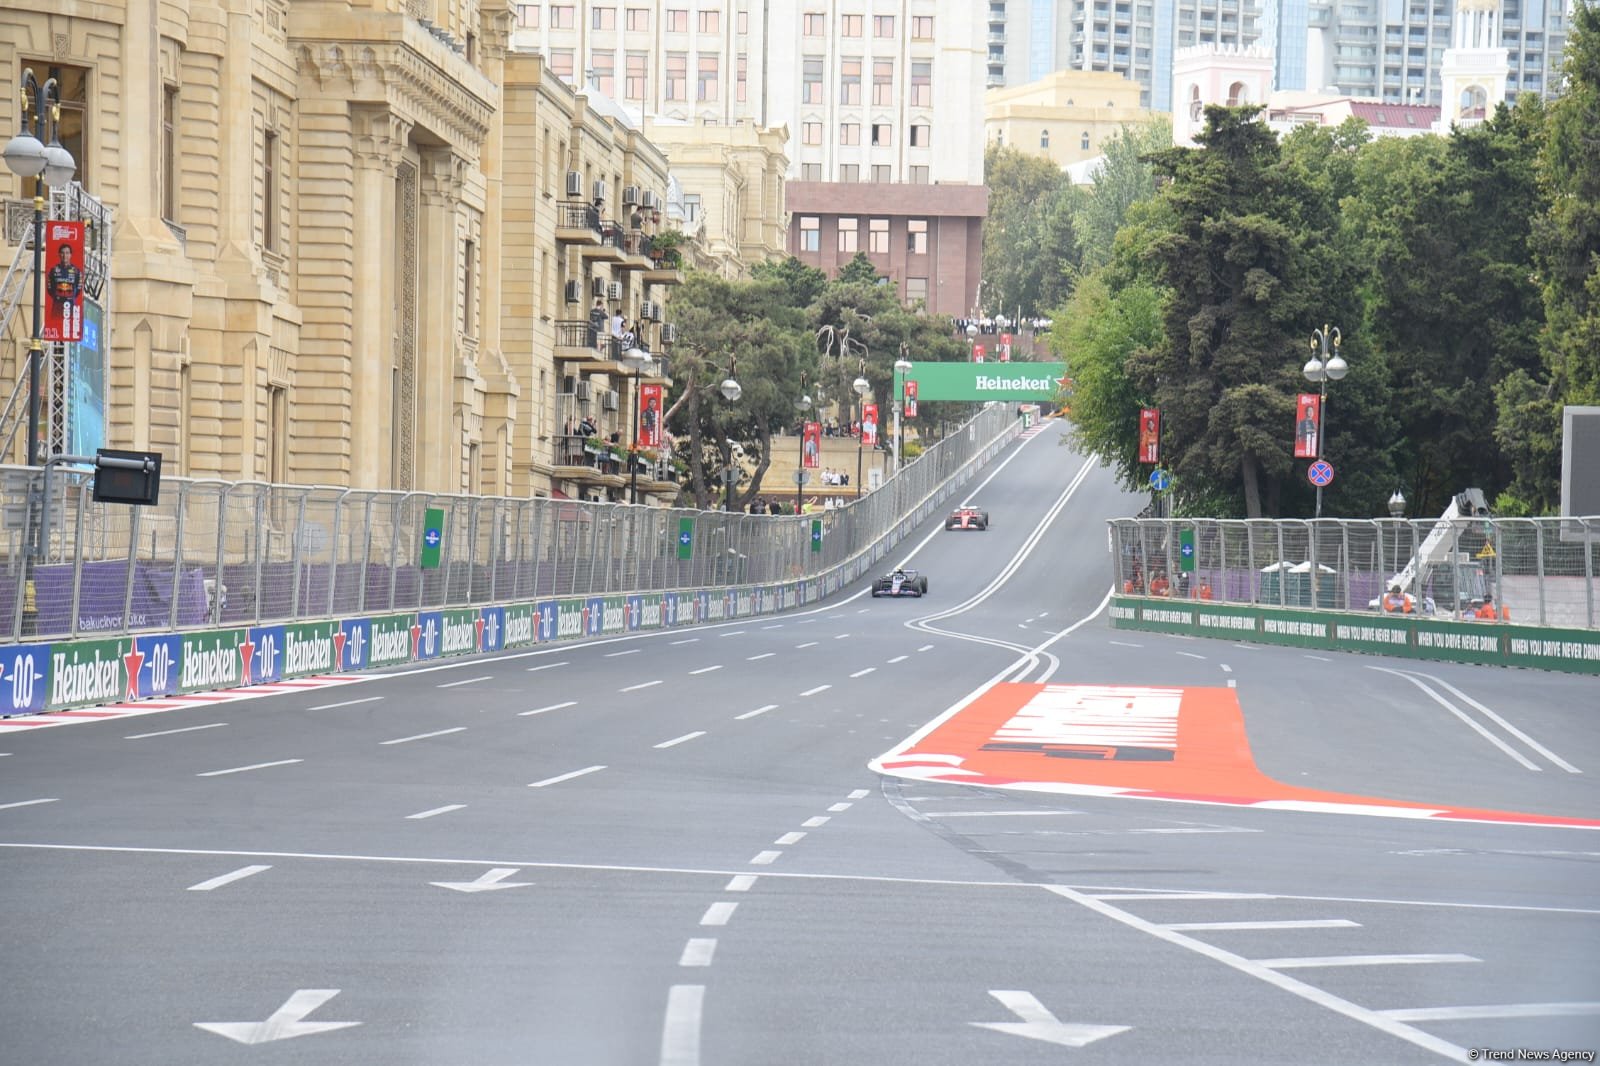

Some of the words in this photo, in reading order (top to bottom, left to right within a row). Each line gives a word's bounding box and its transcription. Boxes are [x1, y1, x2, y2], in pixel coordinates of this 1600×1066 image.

[975, 375, 1050, 390] Heineken
[370, 622, 409, 662] Heineken
[442, 615, 473, 652] Heineken
[1264, 619, 1277, 633] WHEN
[1277, 620, 1286, 634] YOU
[1286, 621, 1300, 635] DRIVE
[1299, 622, 1312, 637] NEVER
[1312, 623, 1326, 638] DRINK
[1336, 625, 1350, 639] WHEN
[1350, 626, 1361, 640] YOU
[1360, 627, 1375, 642] DRIVE
[1375, 628, 1390, 643] NEVER
[1390, 629, 1407, 644] DRINK
[1418, 631, 1433, 647] WHEN
[1433, 632, 1445, 648] YOU
[1445, 633, 1461, 649] DRIVE
[1461, 635, 1479, 651] NEVER
[1480, 636, 1498, 652] DRINK
[285, 629, 331, 674] Heineken
[1511, 638, 1529, 655] WHEN
[1529, 639, 1542, 656] YOU
[1543, 640, 1561, 657] DRIVE
[1562, 642, 1582, 659] NEVER
[51, 649, 120, 704] Heineken
[181, 639, 236, 688] Heineken
